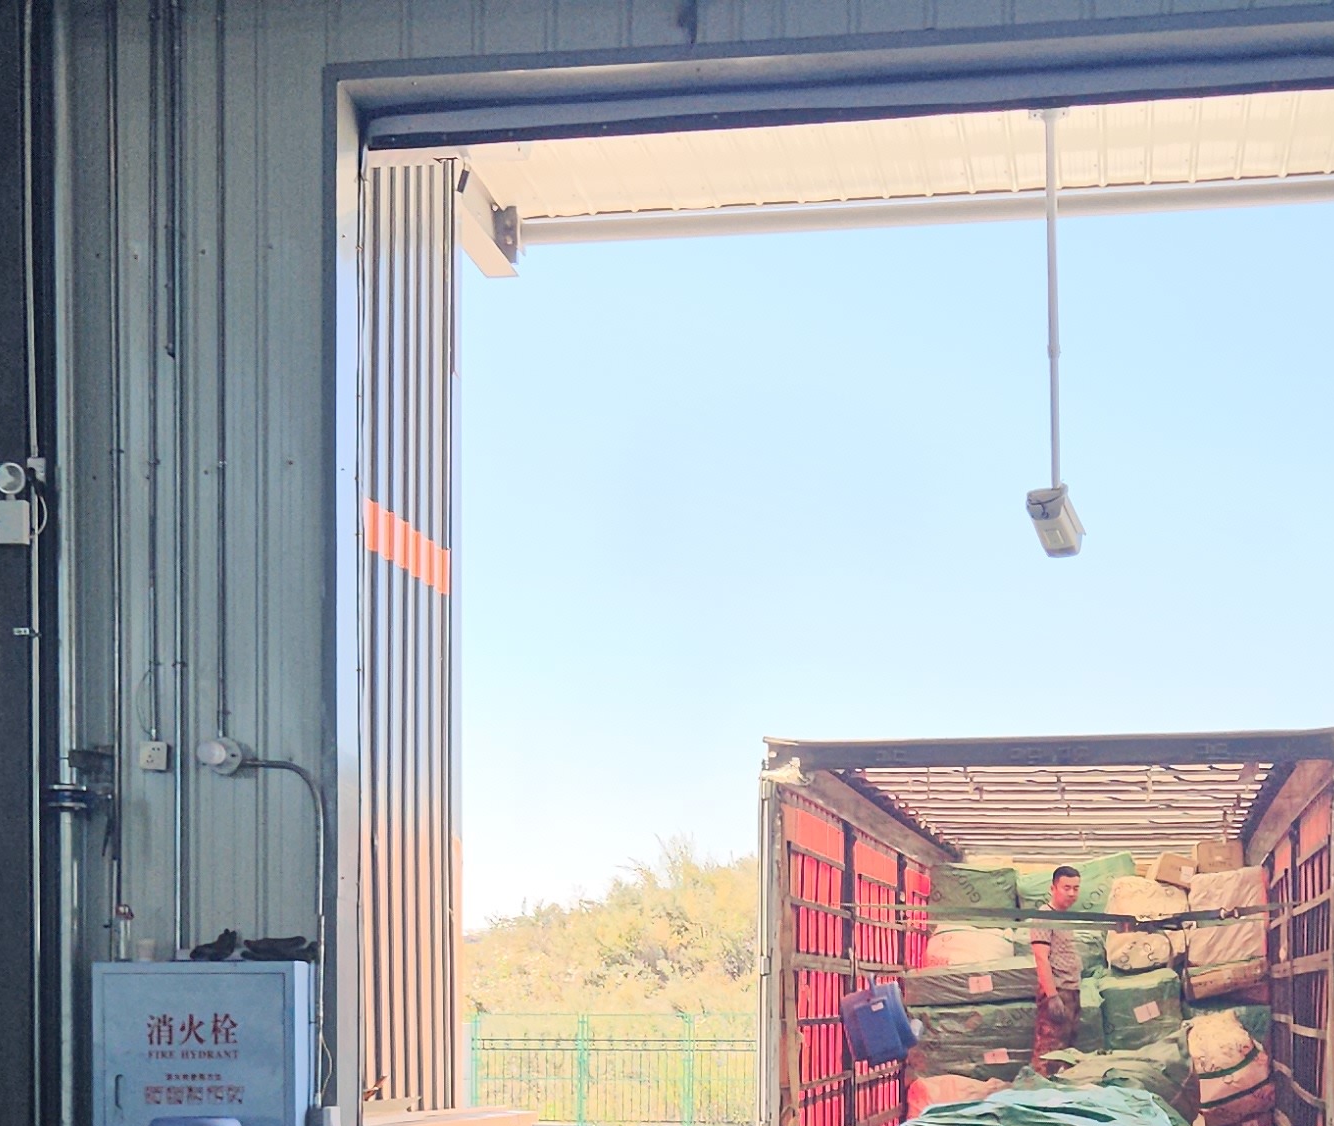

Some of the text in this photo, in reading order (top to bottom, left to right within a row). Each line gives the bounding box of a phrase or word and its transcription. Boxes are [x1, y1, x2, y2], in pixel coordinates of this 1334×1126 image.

[147, 1013, 238, 1045] 消火栓
[148, 1050, 238, 1059] FIRE HYDRANT
